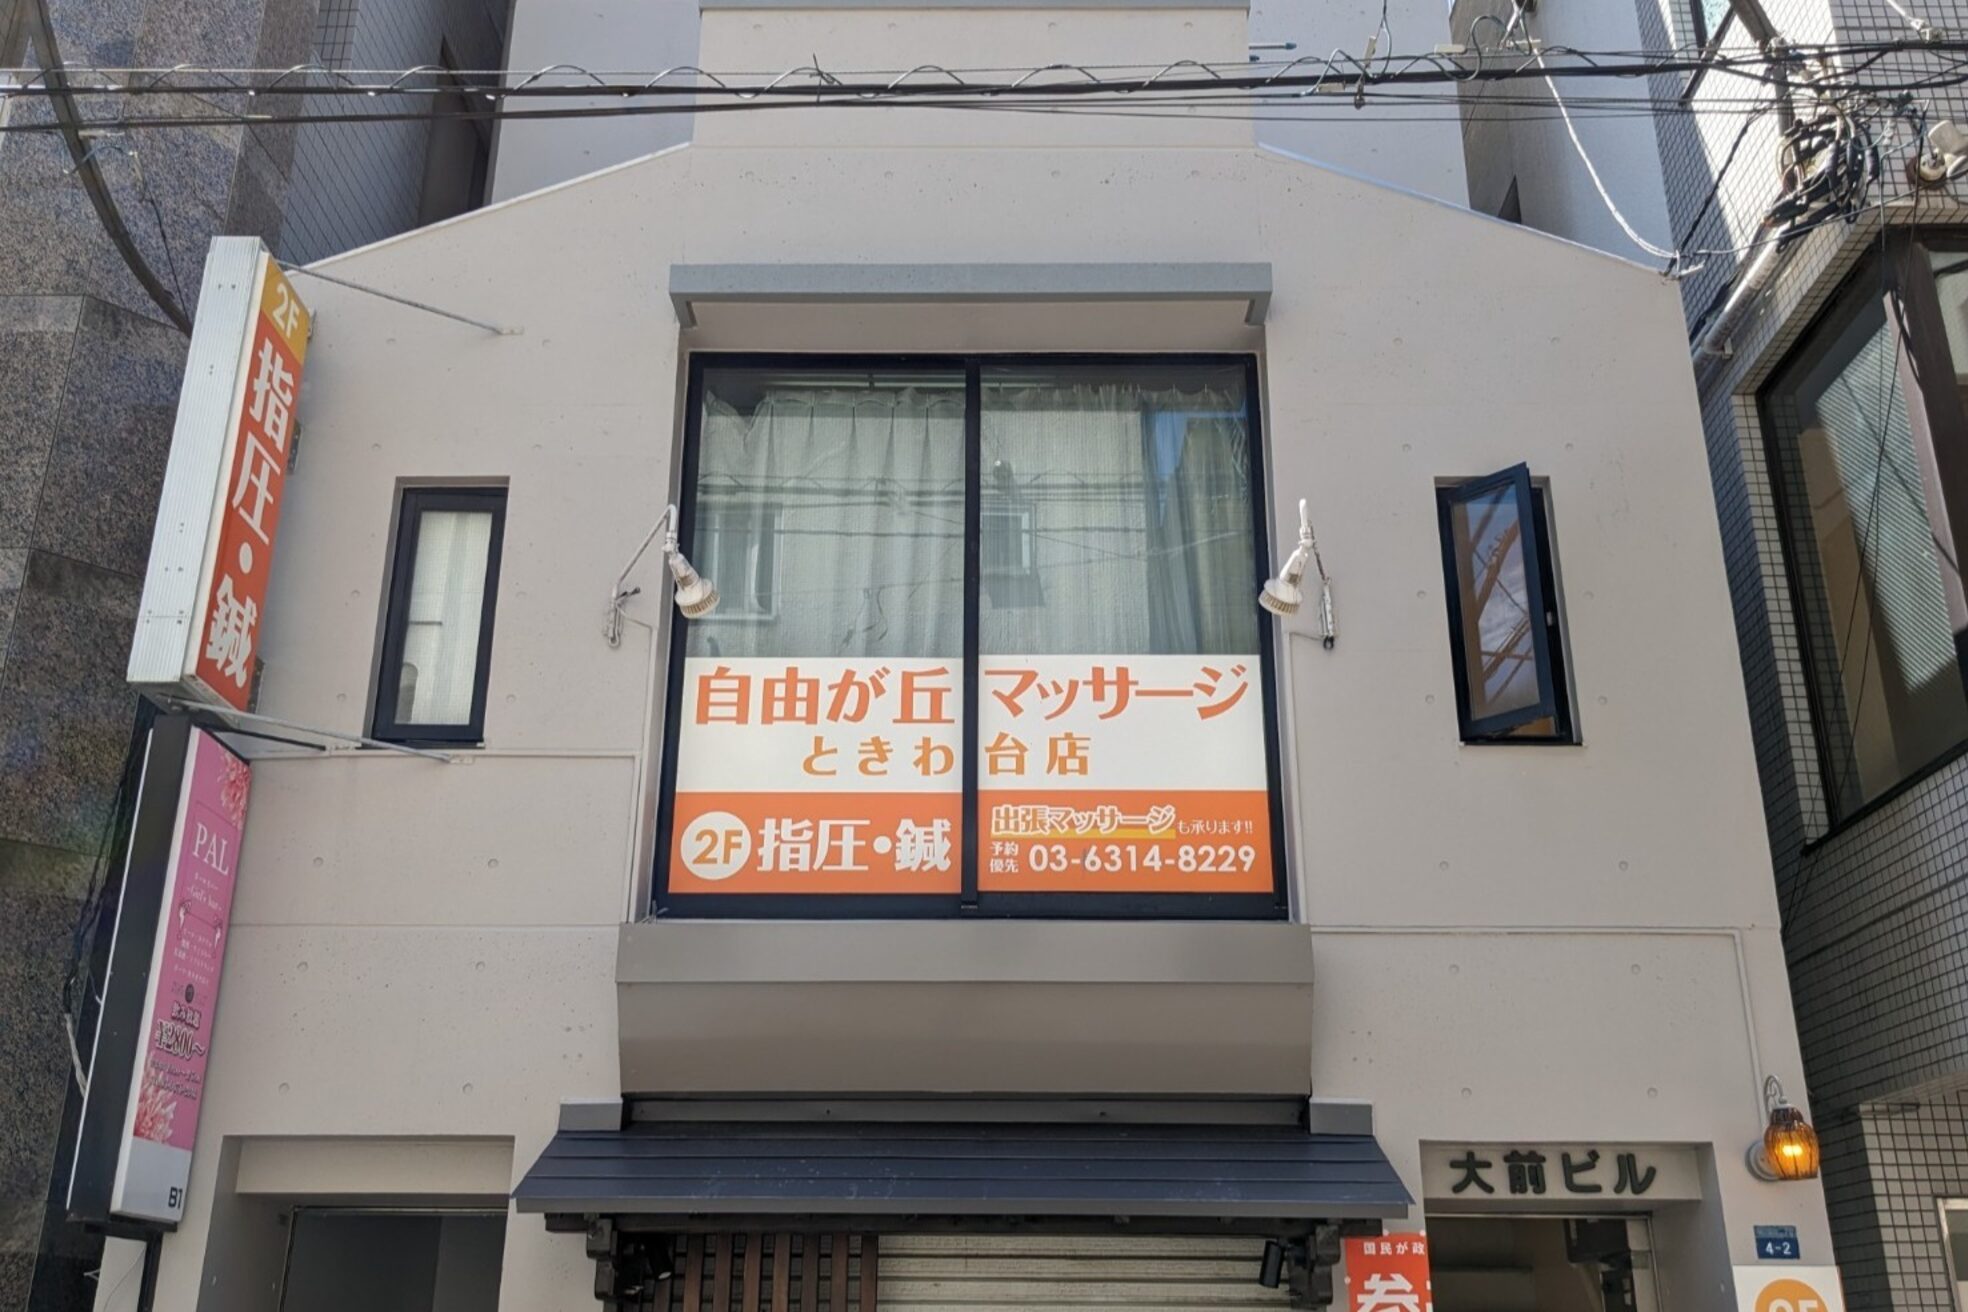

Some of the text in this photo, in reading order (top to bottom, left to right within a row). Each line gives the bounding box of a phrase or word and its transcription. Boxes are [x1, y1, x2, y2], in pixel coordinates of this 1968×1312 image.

[274, 282, 302, 340] 2F
[205, 337, 294, 688] 指圧・鍼
[696, 664, 1248, 725] 自由が丘 マッサージ
[992, 804, 1176, 835] 出張マッサージ
[192, 823, 229, 876] PAL
[692, 818, 951, 872] 2F 指圧・鍼
[1029, 845, 1256, 873] 03-6314-8229
[1449, 1150, 1657, 1195] 大前ビル
[168, 1187, 183, 1208] B1
[1765, 1241, 1791, 1255] 4-2
